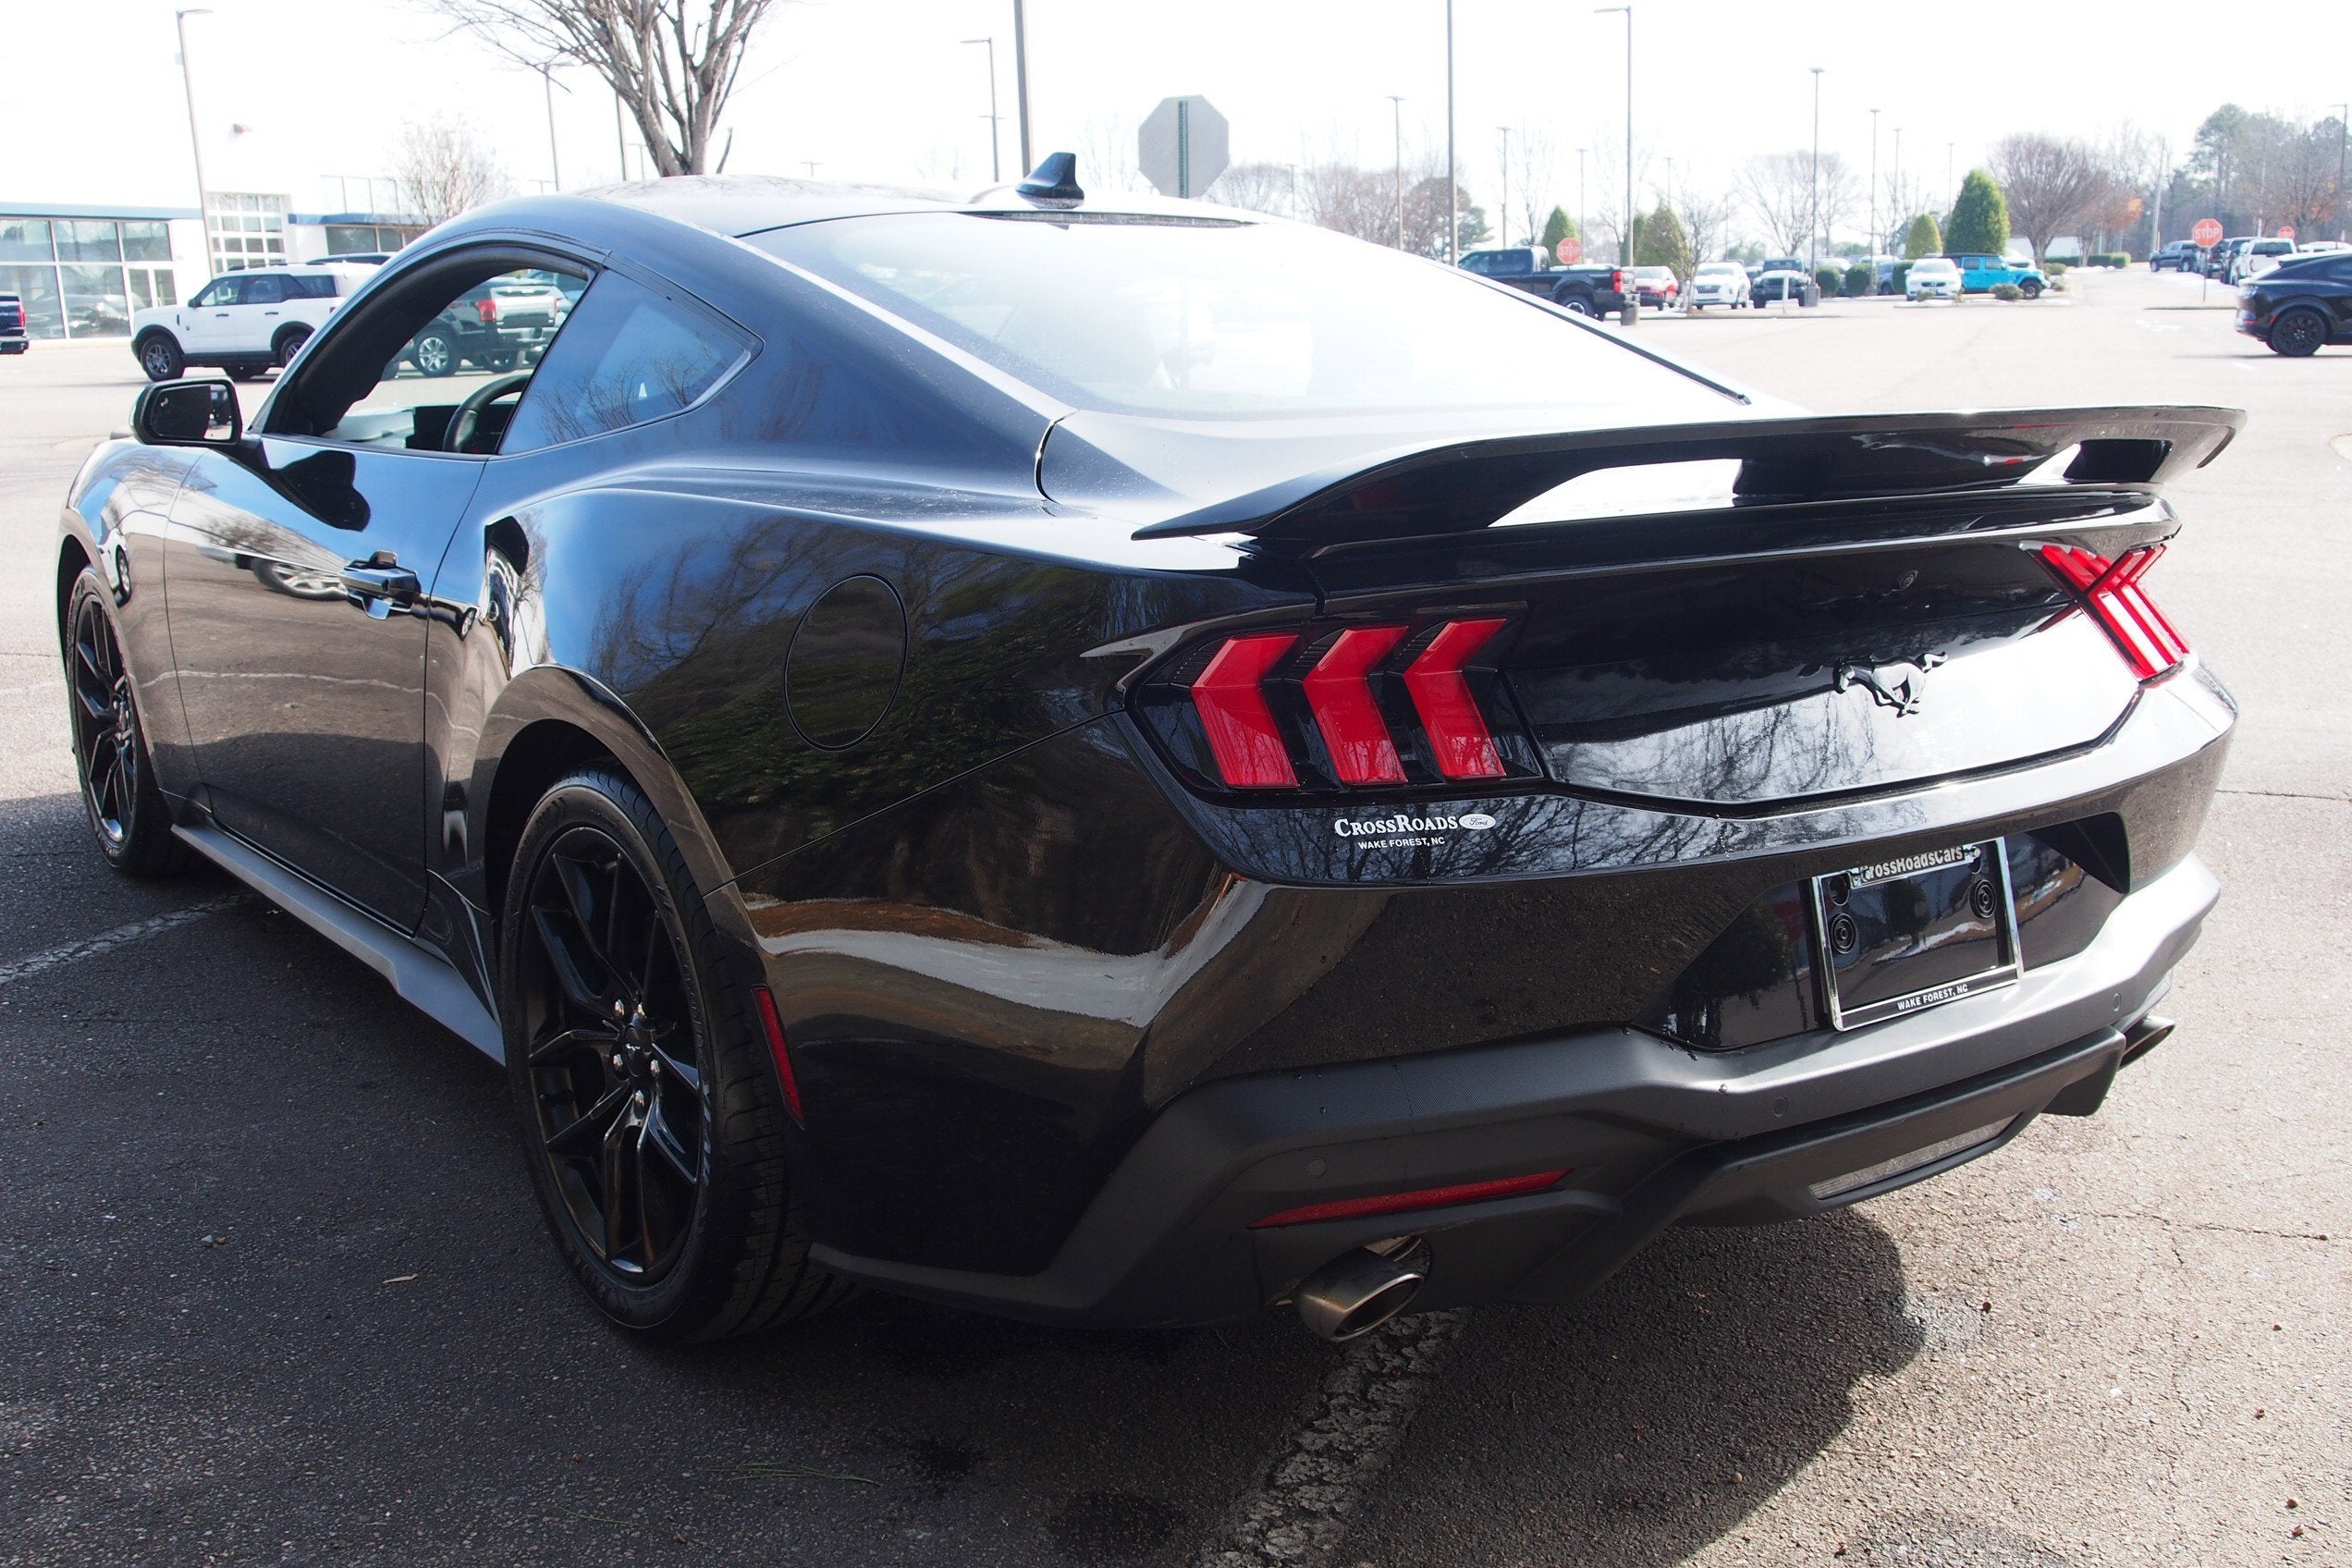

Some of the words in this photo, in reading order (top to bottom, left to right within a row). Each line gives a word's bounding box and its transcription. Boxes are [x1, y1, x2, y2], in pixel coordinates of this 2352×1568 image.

[2195, 227, 2220, 239] STOP
[1357, 839, 1388, 850] WAKE
[1389, 837, 1431, 848] FOREST,
[1431, 836, 1446, 845] NC
[1897, 997, 1922, 1011] WAKE
[1923, 987, 1955, 1003] FOREST,
[1956, 984, 1968, 995] NC
